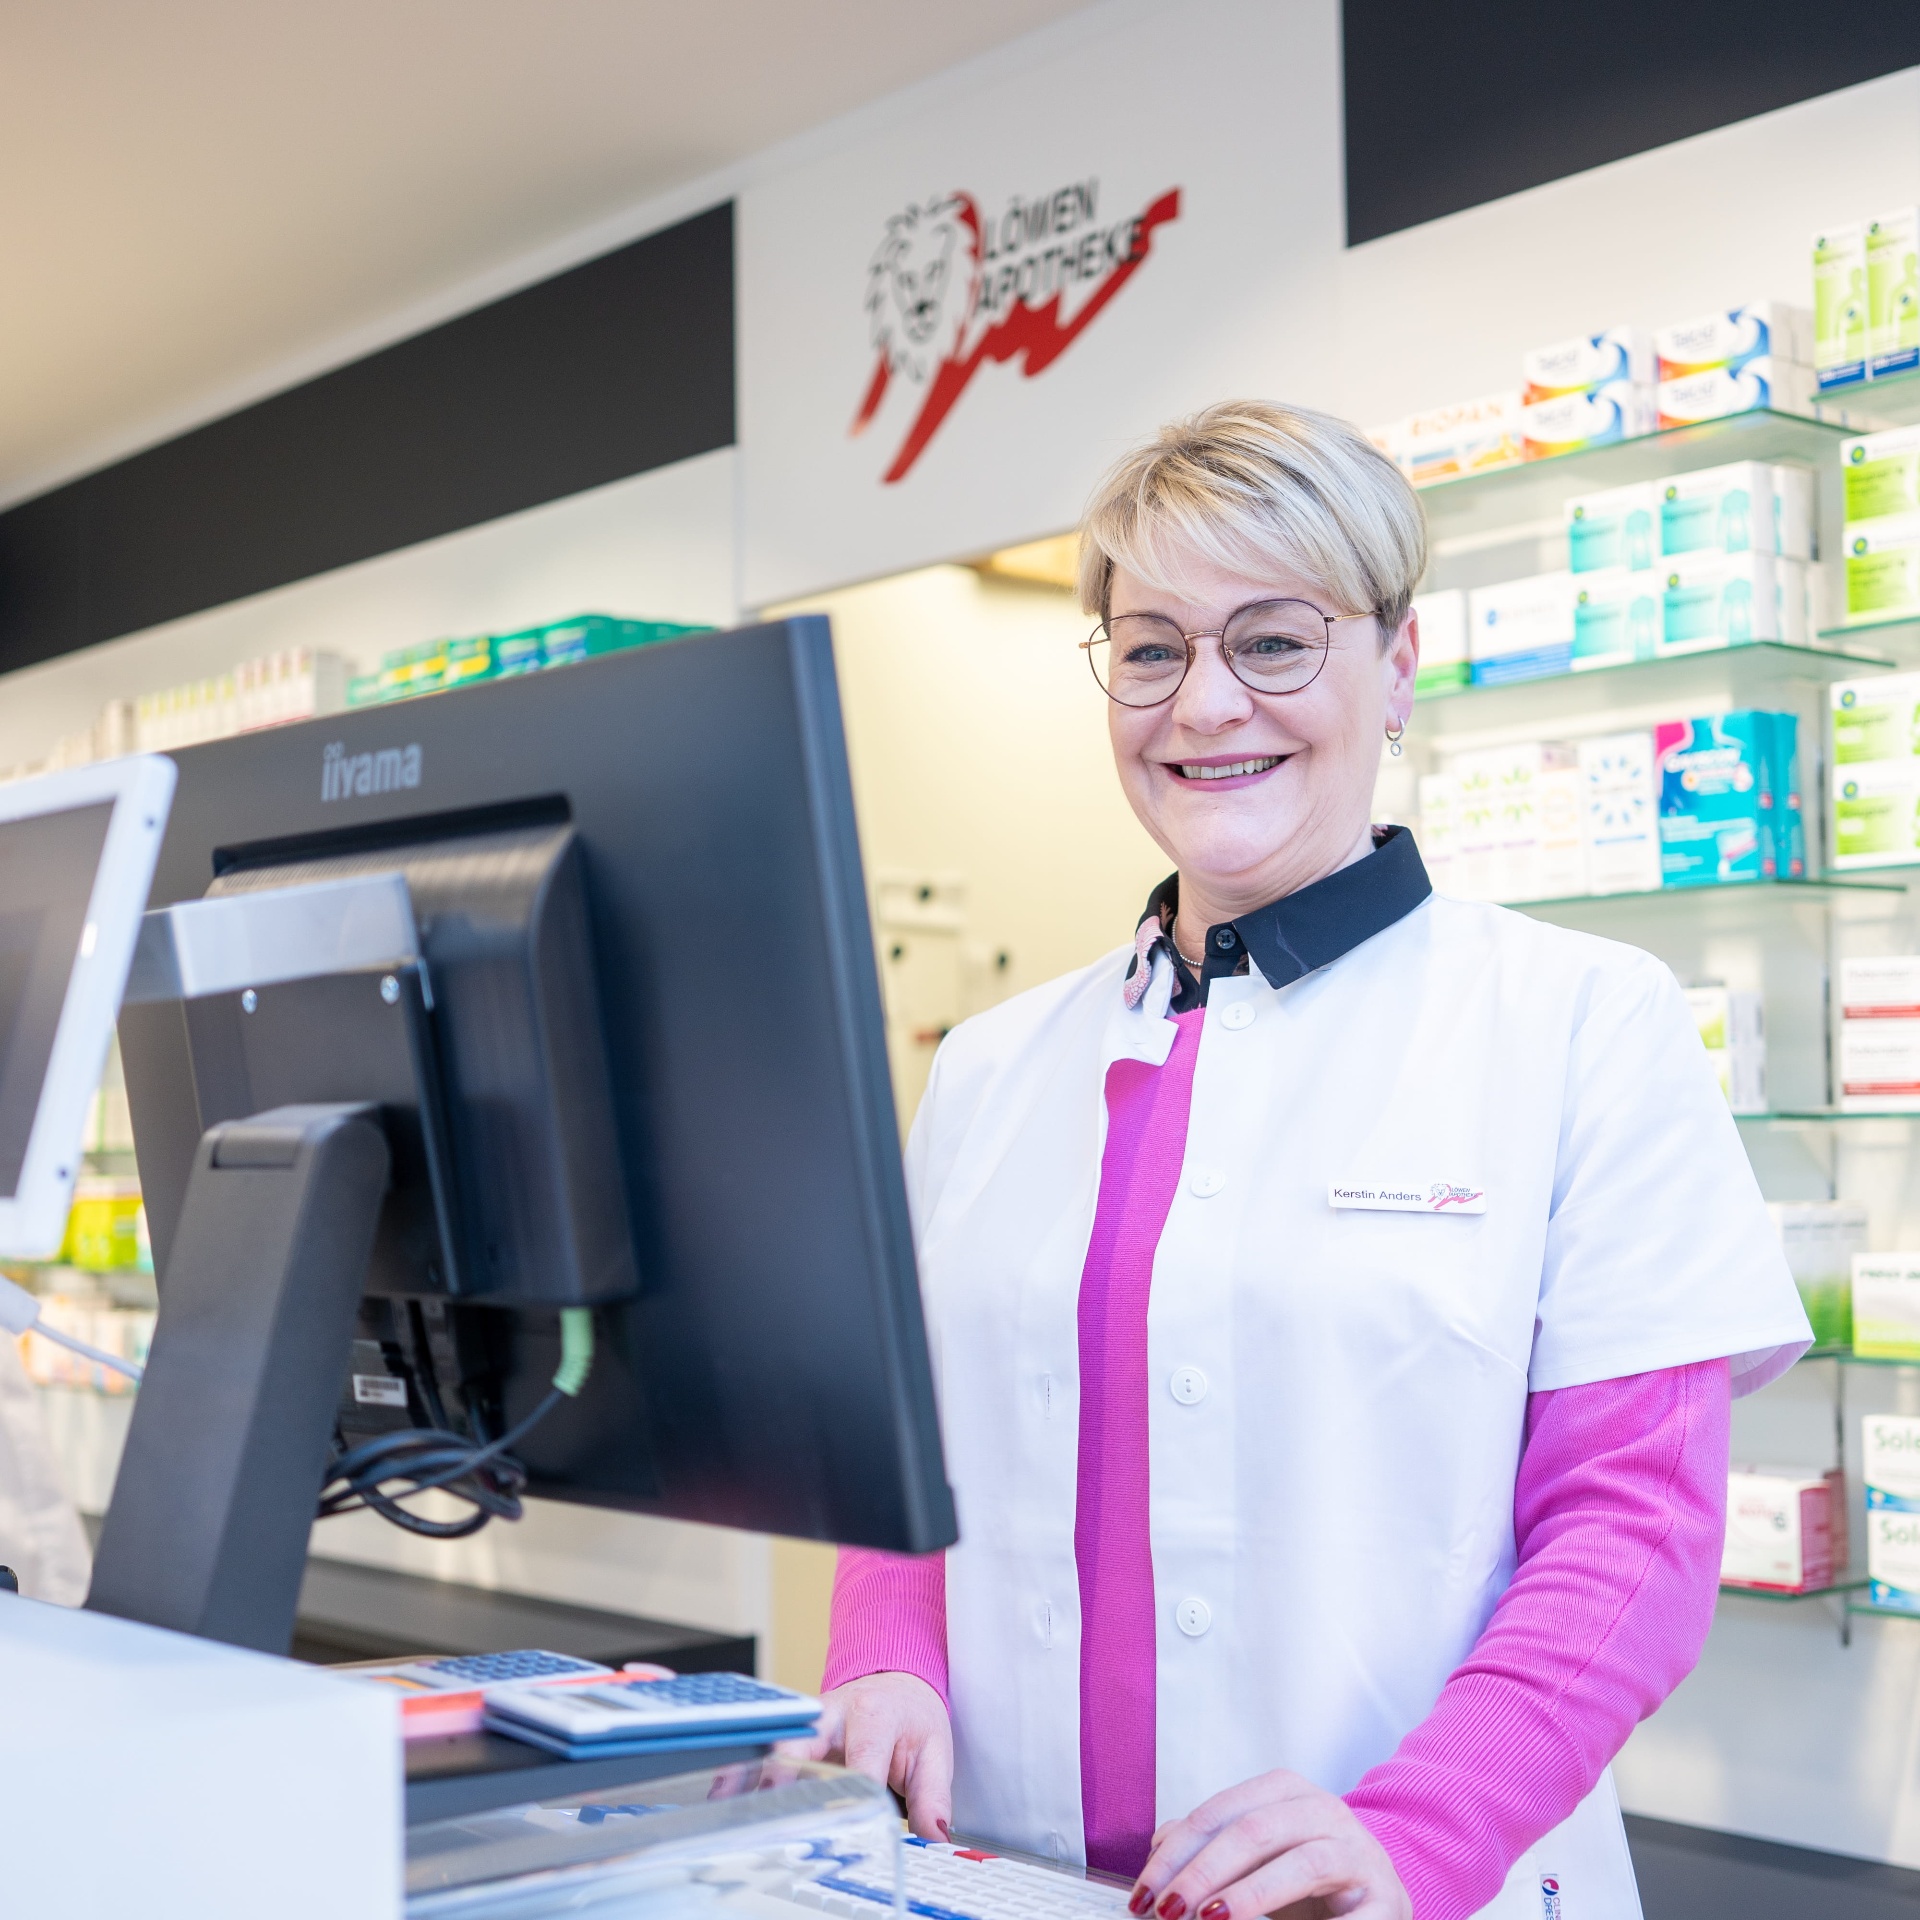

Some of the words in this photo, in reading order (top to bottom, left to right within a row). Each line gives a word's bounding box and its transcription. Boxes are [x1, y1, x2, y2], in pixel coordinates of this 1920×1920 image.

[984, 177, 1099, 259] LÖWEN
[979, 216, 1147, 311] APOTHEKE
[322, 742, 422, 802] iiyama
[1334, 1188, 1375, 1199] Kerstin
[1379, 1190, 1422, 1201] Anders
